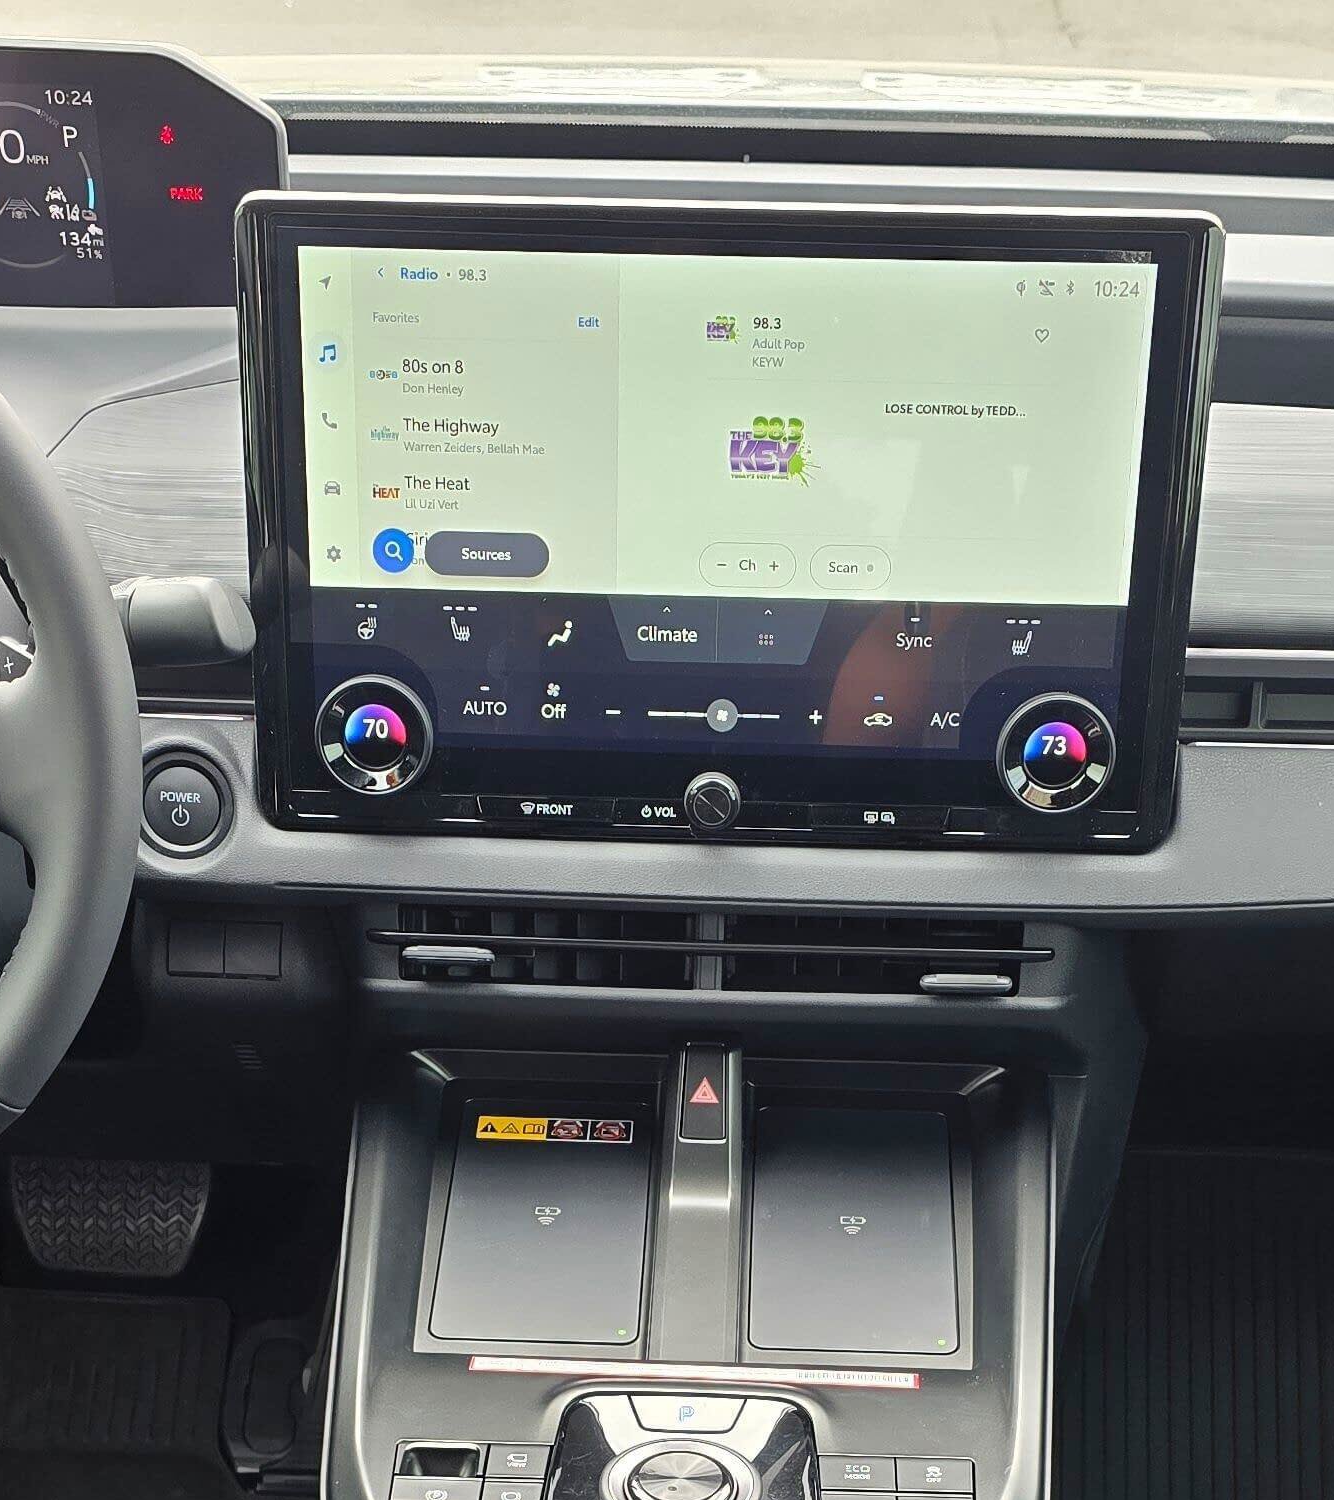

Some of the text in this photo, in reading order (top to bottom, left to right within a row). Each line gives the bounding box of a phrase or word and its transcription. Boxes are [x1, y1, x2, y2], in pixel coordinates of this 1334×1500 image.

[45, 89, 93, 106] 10:24
[39, 110, 60, 128] PWR
[62, 125, 78, 148] P
[0, 129, 50, 166] 0 MPH
[170, 187, 204, 201] PARK
[76, 248, 103, 260] 51%
[400, 267, 487, 281] Radio 98.3
[1094, 280, 1140, 298] 10:24
[372, 311, 420, 323] Favorites
[578, 317, 600, 328] Edit
[753, 317, 782, 330] 98.3
[752, 338, 805, 352] Adult Pop
[402, 358, 464, 374] 80s on 8
[752, 356, 785, 368] KEYW
[402, 383, 464, 397] Don Henley
[885, 403, 914, 415] LOSE
[915, 404, 969, 416] CONTROL
[971, 403, 985, 418] by
[403, 418, 499, 437] The Highway
[752, 416, 805, 443] 98.3
[730, 430, 752, 441] THE
[403, 441, 545, 455] Warren Zeiders, Bellah Mae
[730, 439, 800, 474] KEY
[404, 475, 471, 491] The Heat
[372, 486, 401, 499] HEAT
[405, 499, 459, 510] Lil Uzi Vert
[461, 547, 512, 561] Sources
[739, 558, 756, 571] Ch
[828, 561, 858, 574] Scan
[637, 625, 698, 643] Climate
[896, 632, 933, 650] Sync
[462, 700, 508, 716] AUTO
[541, 703, 567, 719] Off
[930, 711, 961, 729] A/C
[363, 718, 389, 739] 70
[1041, 735, 1067, 756] 73
[160, 790, 201, 804] POWER
[536, 803, 574, 816] FRONT
[653, 806, 677, 818] VOL
[679, 1405, 695, 1422] P
[845, 1464, 871, 1473] ECO
